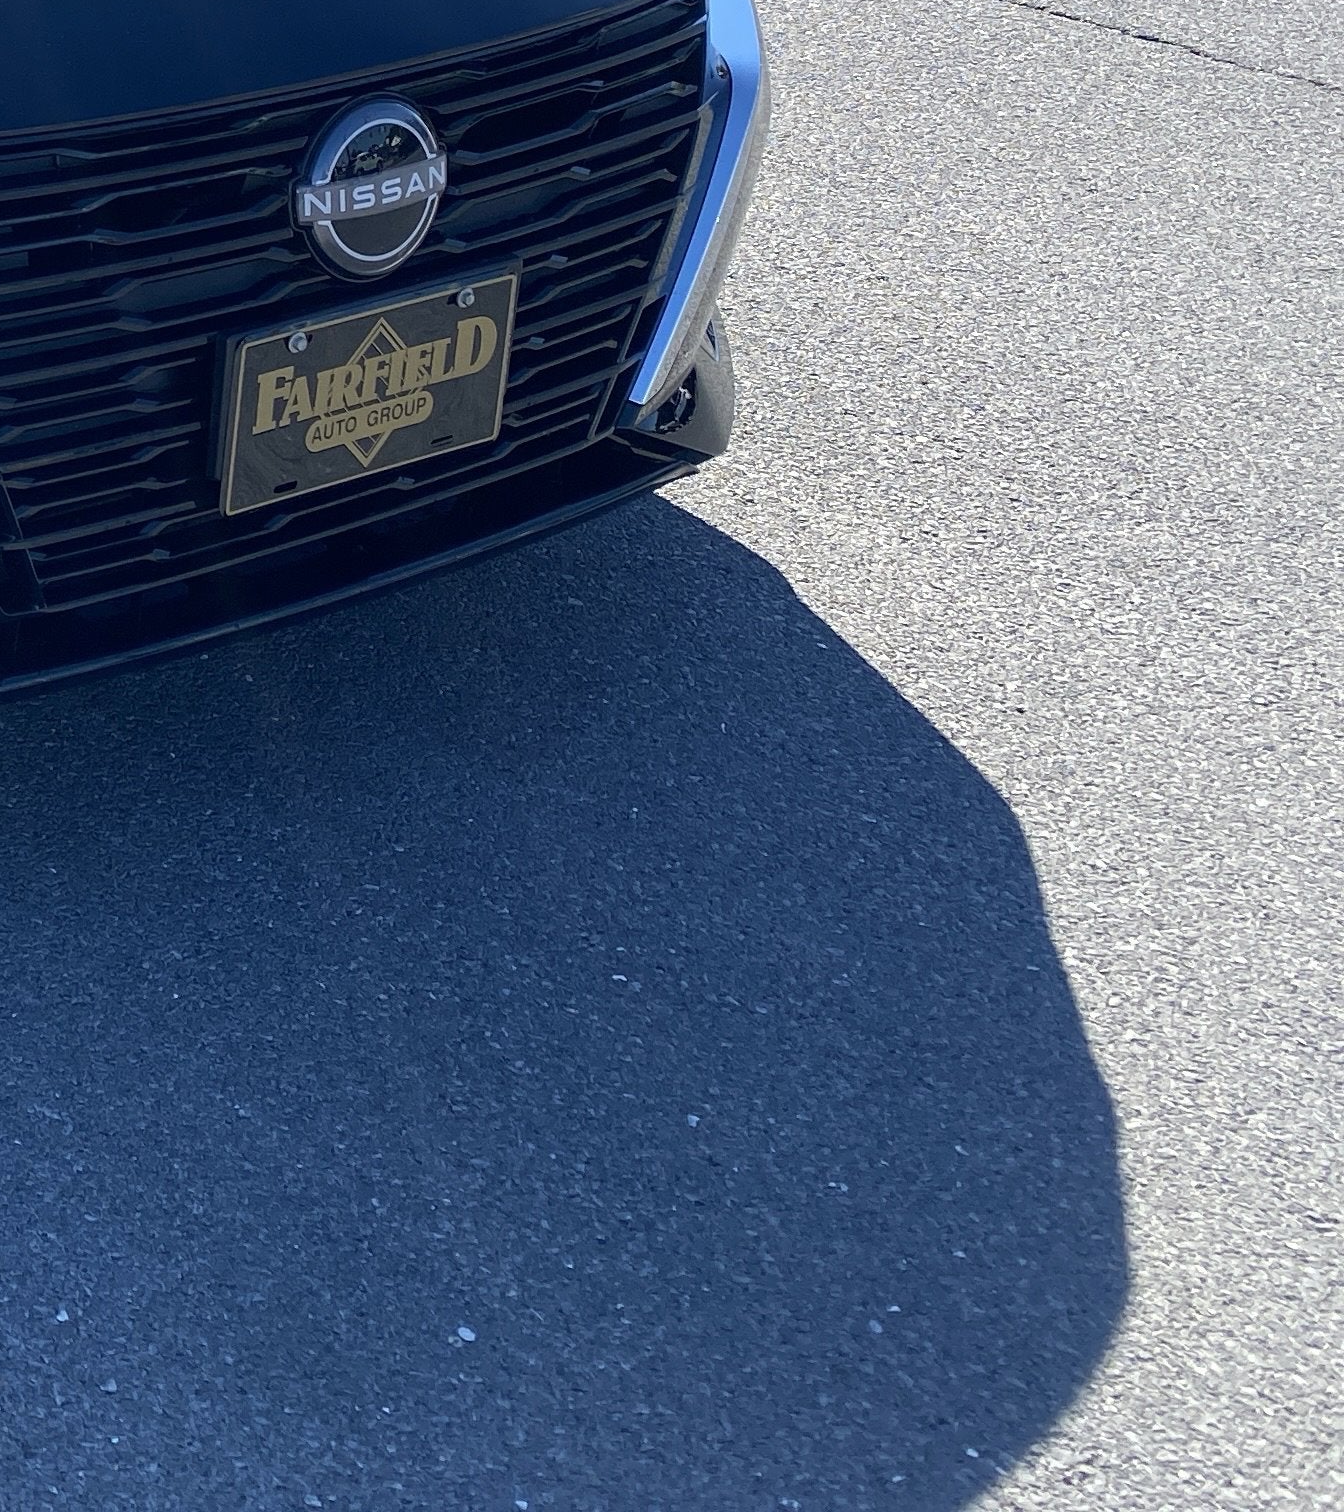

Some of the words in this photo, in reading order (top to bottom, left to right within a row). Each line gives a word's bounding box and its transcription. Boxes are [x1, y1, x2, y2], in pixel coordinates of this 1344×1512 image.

[303, 160, 447, 218] NISSAN
[251, 315, 498, 436] FAIRFIELD
[312, 416, 358, 443] AUTO
[366, 395, 428, 429] GROUP
